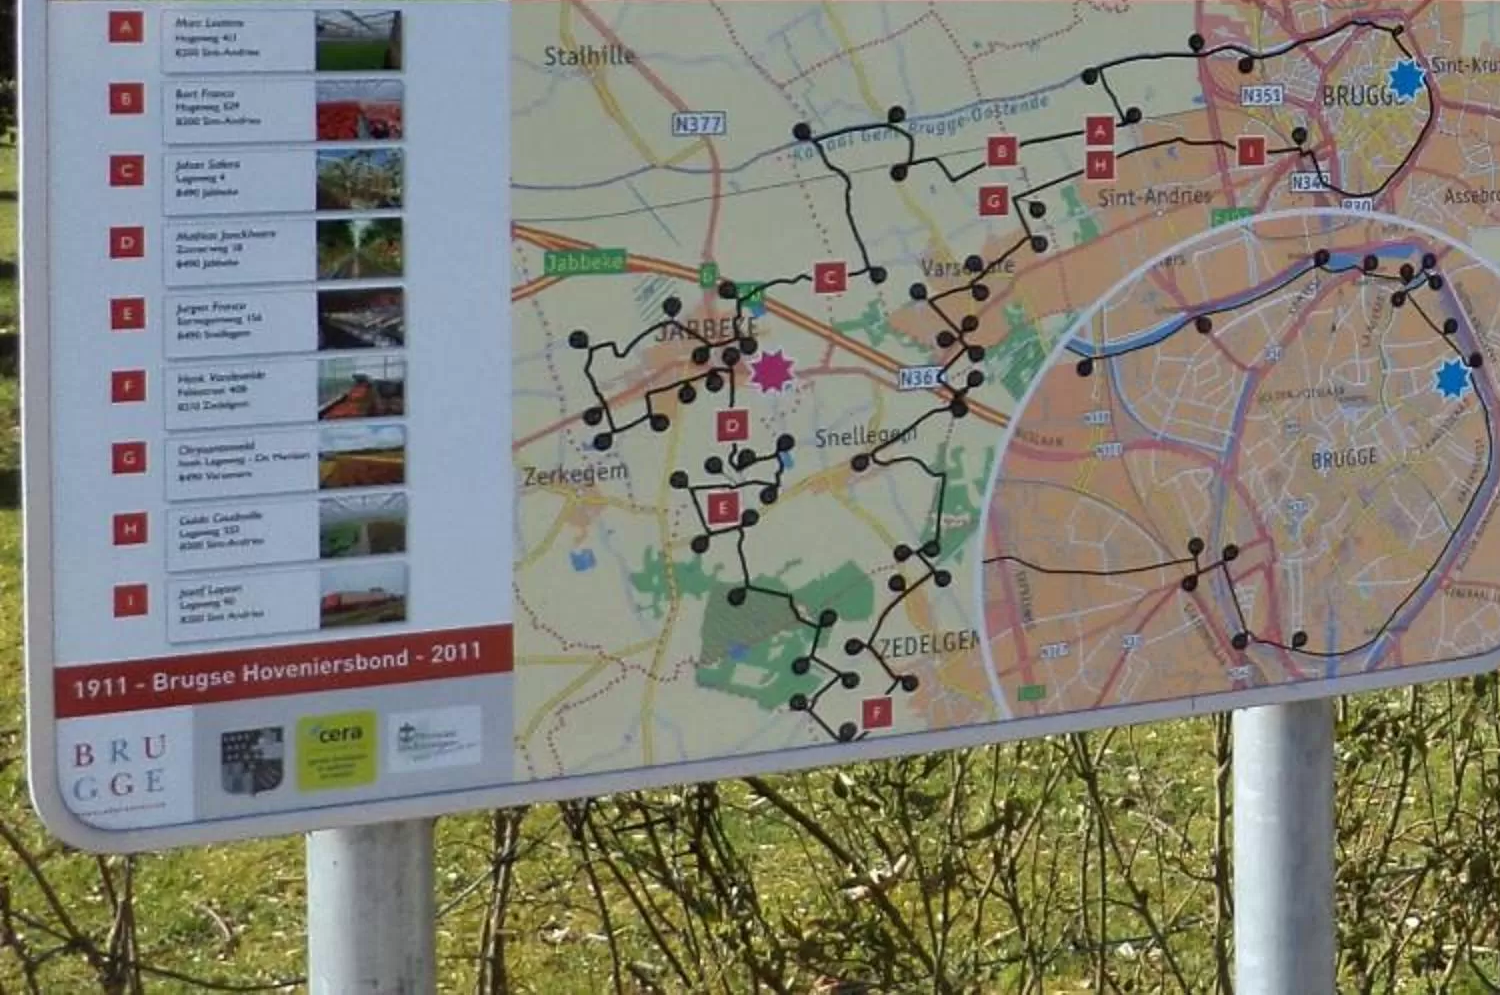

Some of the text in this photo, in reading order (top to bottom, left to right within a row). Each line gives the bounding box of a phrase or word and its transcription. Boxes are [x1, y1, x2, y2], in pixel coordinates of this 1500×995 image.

[543, 44, 637, 68] Stalhille
[1242, 85, 1282, 104] N351
[1323, 83, 1407, 106] BRUGG
[675, 115, 723, 133] N377
[1098, 185, 1213, 207] Sint-Andries
[547, 252, 626, 272] Jabbeke
[1311, 449, 1378, 470] BRUGGE
[523, 463, 629, 489] Zerkegem
[73, 678, 128, 700] 1911
[152, 667, 235, 693] Brugse
[241, 642, 409, 685] Hoveniersbond
[431, 640, 482, 664] 2011
[319, 725, 365, 744] cera
